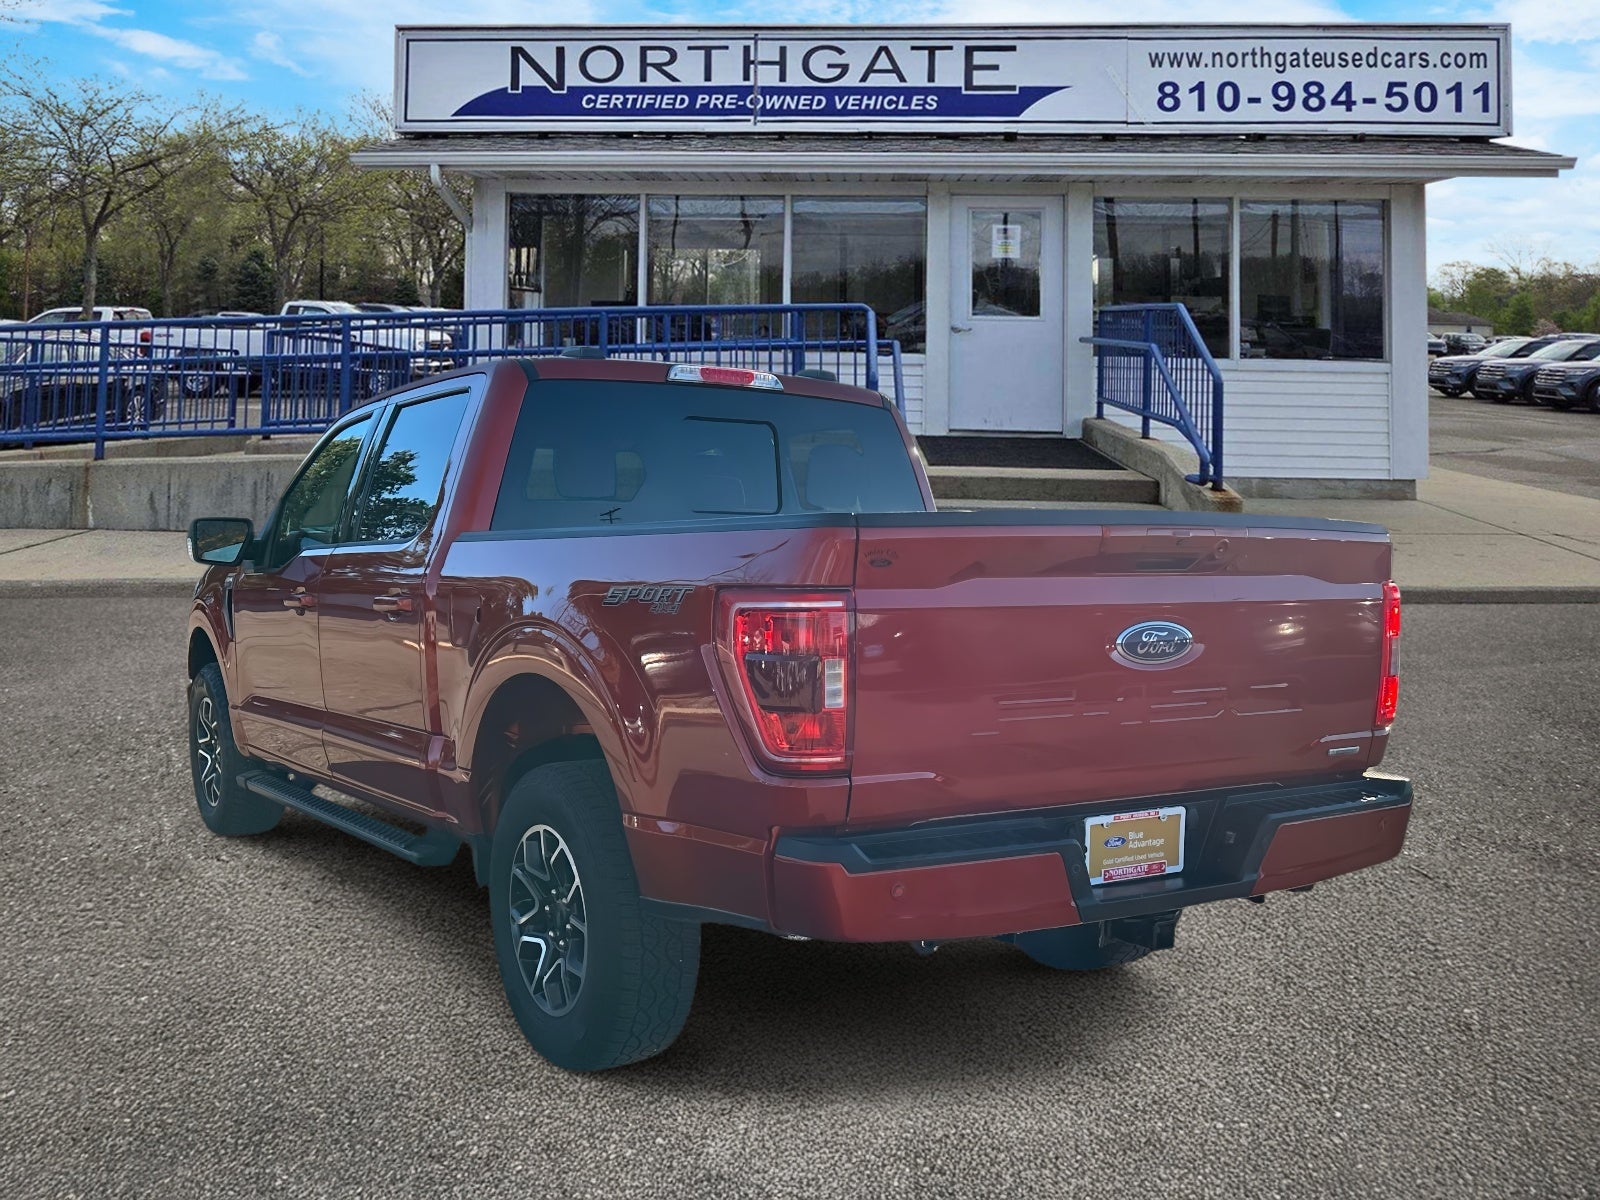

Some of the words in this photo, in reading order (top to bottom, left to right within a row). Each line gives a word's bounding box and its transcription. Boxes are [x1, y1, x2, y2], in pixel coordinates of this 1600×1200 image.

[510, 44, 1018, 92] NORTHGATE
[1148, 46, 1488, 74] www.northgateusedcars.com
[581, 94, 689, 109] CERTIFIED
[695, 94, 827, 110] PRE-OWNED
[834, 94, 939, 110] VEHICLES
[1157, 80, 1490, 113] 810-984-5011
[602, 586, 696, 607] SPORT
[1137, 630, 1178, 655] Ford
[1106, 837, 1123, 848] Ford
[1128, 831, 1143, 840] Blue
[1128, 838, 1164, 849] Advantage
